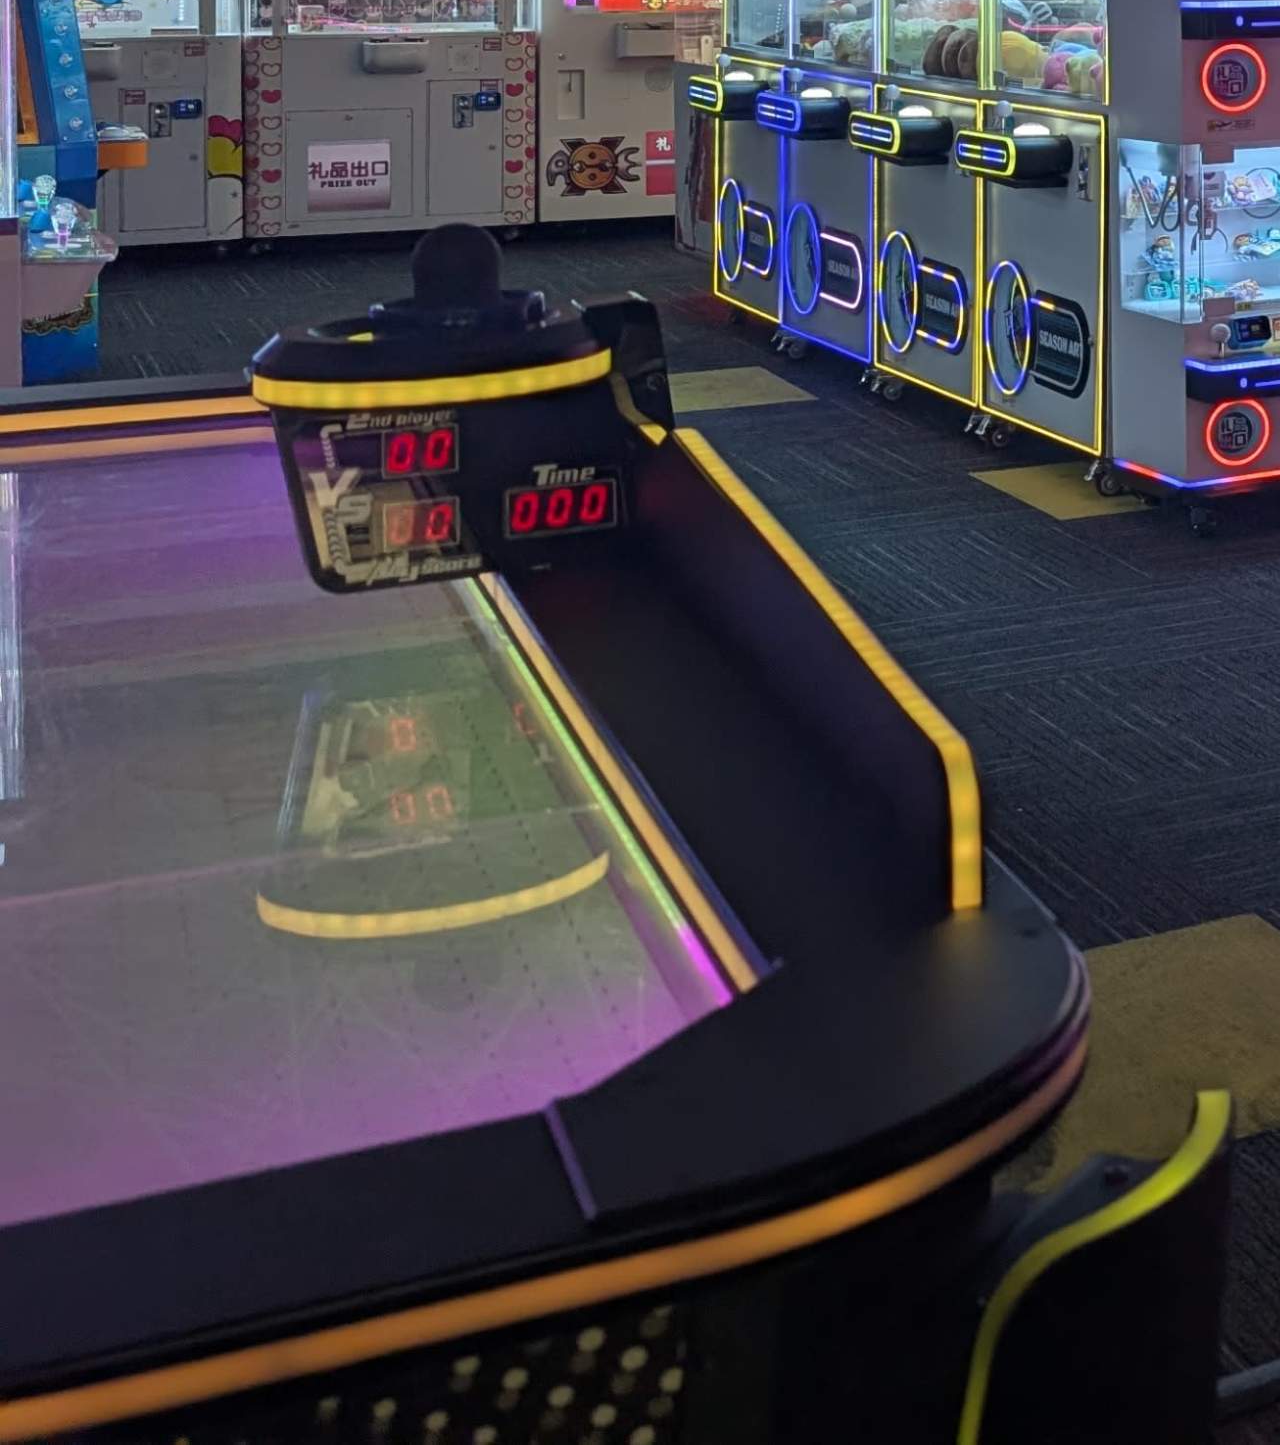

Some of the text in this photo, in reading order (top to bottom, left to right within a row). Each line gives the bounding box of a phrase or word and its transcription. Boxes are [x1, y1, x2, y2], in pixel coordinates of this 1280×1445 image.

[308, 160, 389, 180] 礼品出口
[320, 179, 377, 189] PRIZE OUT
[926, 294, 950, 313] SEASON
[1040, 330, 1068, 353] SEASON
[385, 429, 453, 474] 00
[533, 463, 595, 486] Time
[511, 484, 608, 533] 000
